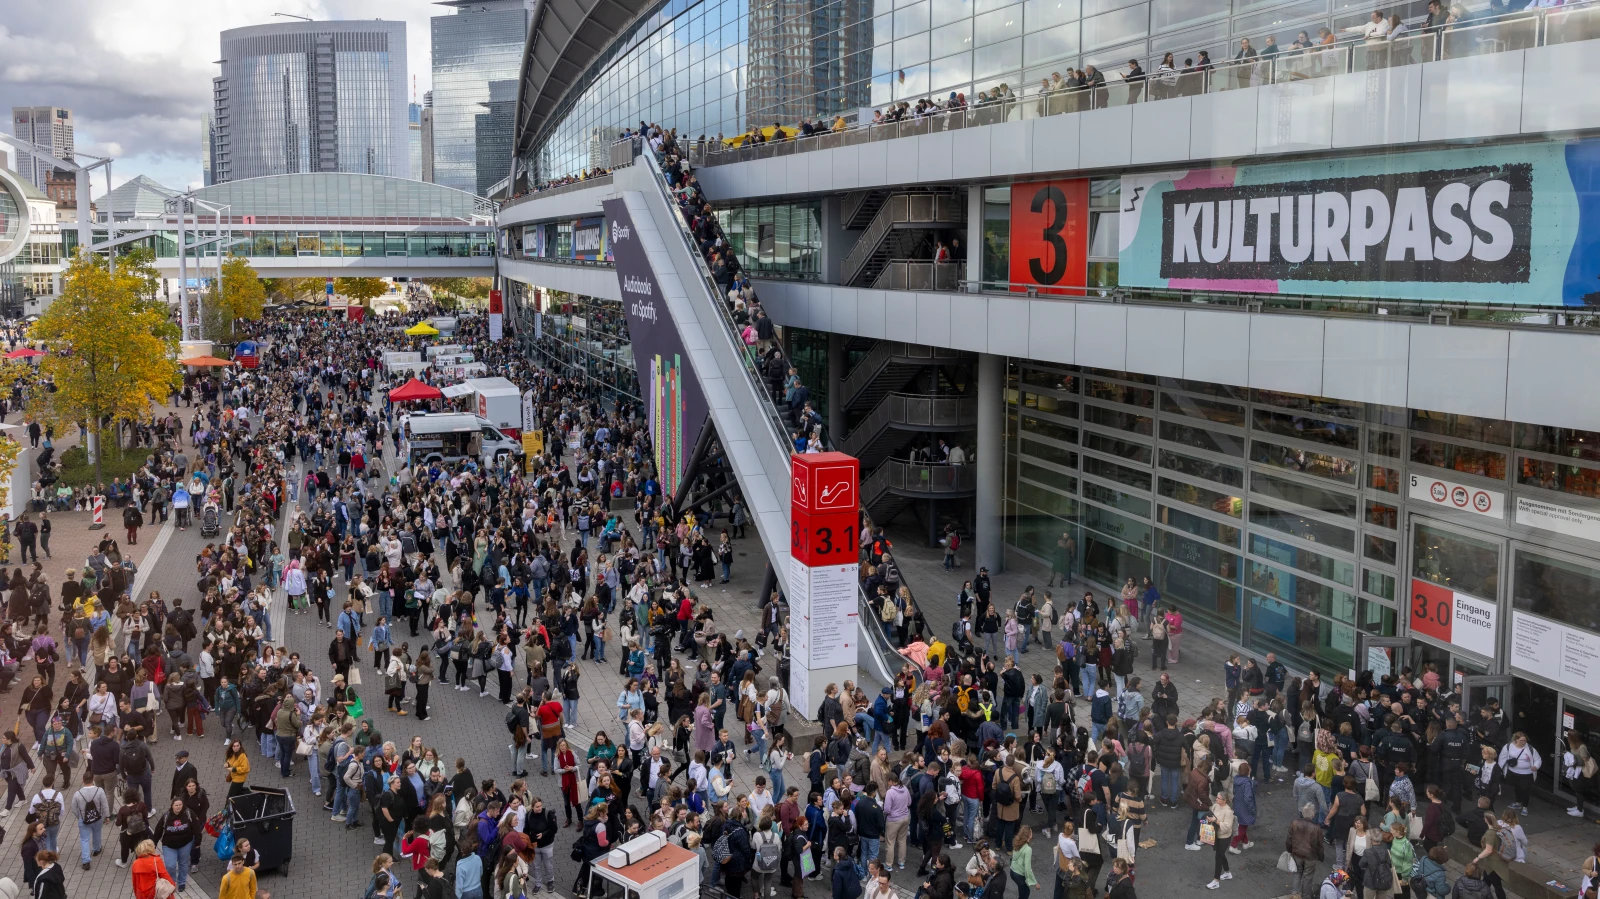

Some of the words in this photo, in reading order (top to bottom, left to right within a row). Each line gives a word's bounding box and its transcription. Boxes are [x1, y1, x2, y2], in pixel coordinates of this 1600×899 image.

[246, 216, 252, 224] 1
[1171, 180, 1514, 264] KULTURPASS
[576, 227, 600, 250] KULTURPASS
[618, 224, 630, 240] Spotify
[1028, 185, 1068, 286] 3
[624, 275, 652, 295] Audiobooks
[493, 304, 499, 312] 3
[631, 302, 638, 316] on
[638, 299, 657, 324] Spotify.
[1411, 476, 1417, 487] 5
[1531, 508, 1548, 516] special
[1549, 512, 1570, 521] approval
[793, 520, 808, 553] 3.1
[816, 526, 853, 555] 3.1
[1414, 594, 1450, 626] 3.0
[1456, 600, 1491, 619] Eingang
[1456, 610, 1492, 629] Entrance
